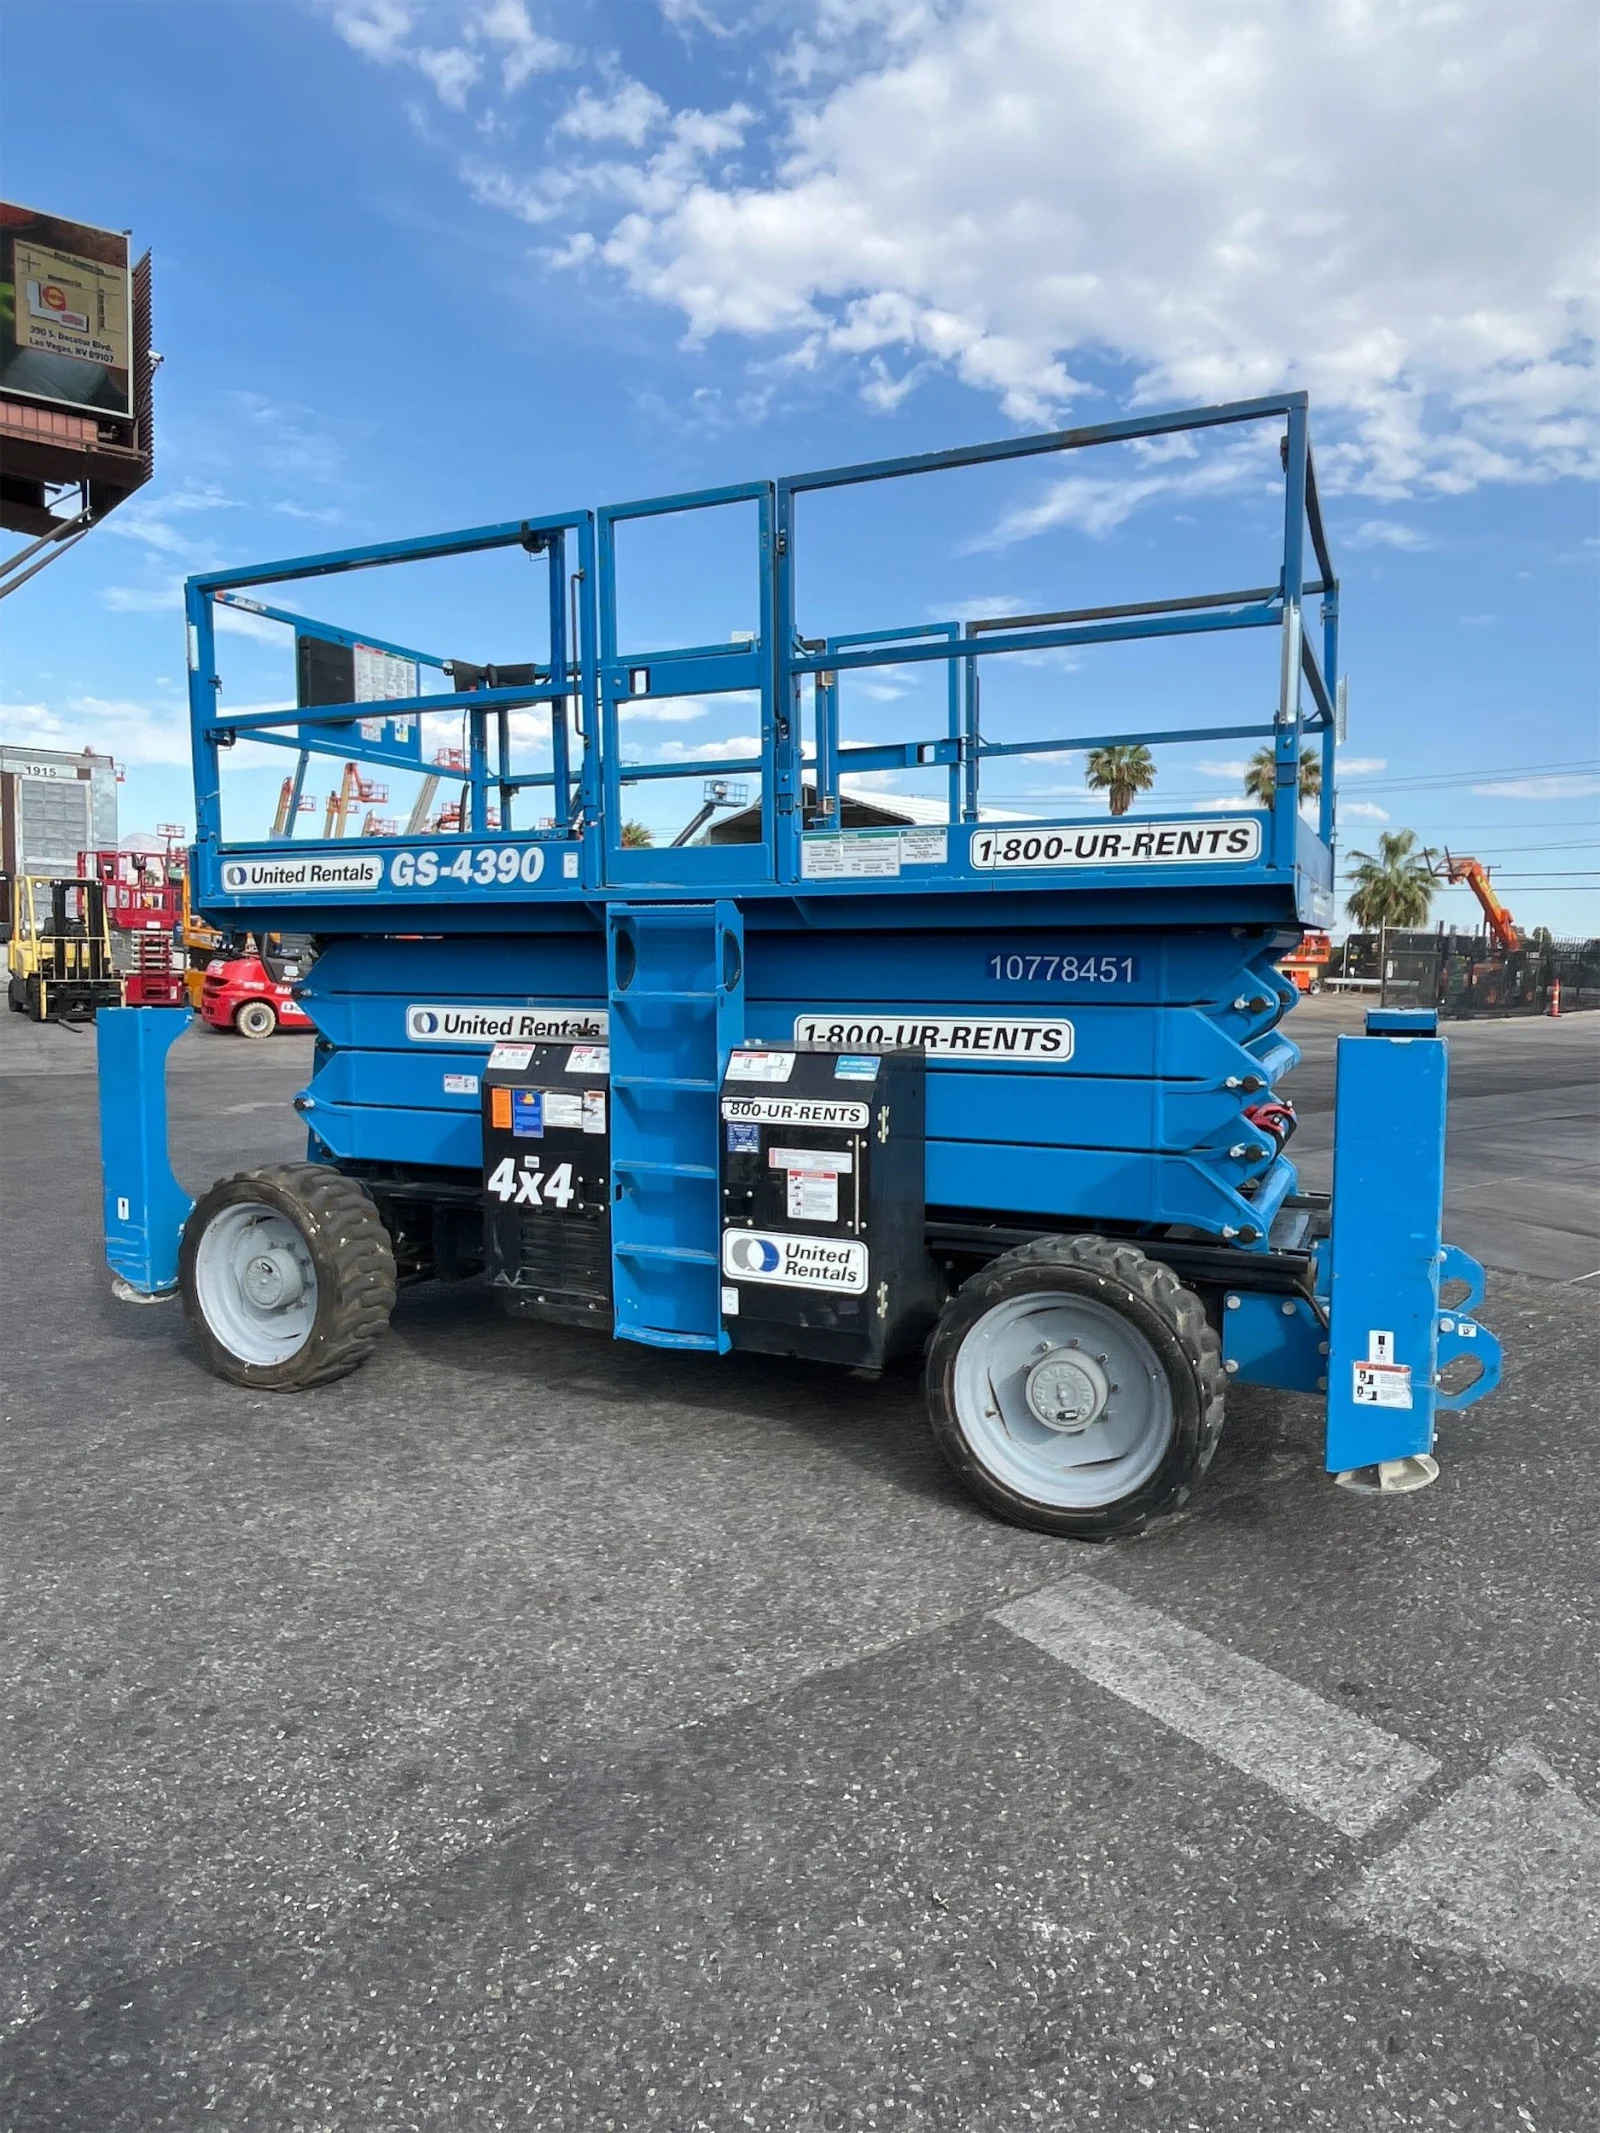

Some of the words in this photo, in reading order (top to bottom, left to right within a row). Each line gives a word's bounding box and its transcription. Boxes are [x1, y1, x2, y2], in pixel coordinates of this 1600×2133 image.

[30, 325, 46, 336] 390
[29, 336, 44, 347] Las
[75, 347, 87, 356] NV
[88, 350, 114, 363] 89107
[25, 765, 56, 777] 1915
[978, 828, 1251, 862] 1-800-UR-RENTS
[251, 865, 305, 884] United
[310, 863, 374, 882] Rentals
[390, 847, 545, 887] GS-4390
[990, 955, 1133, 983] 10778451
[444, 1014, 514, 1036] United
[519, 1016, 601, 1037] Rentals
[804, 1024, 1063, 1052] 1-800-UR-RENTS
[488, 1158, 575, 1208] 4x4
[785, 1242, 851, 1264] United
[785, 1261, 857, 1282] Rentals
